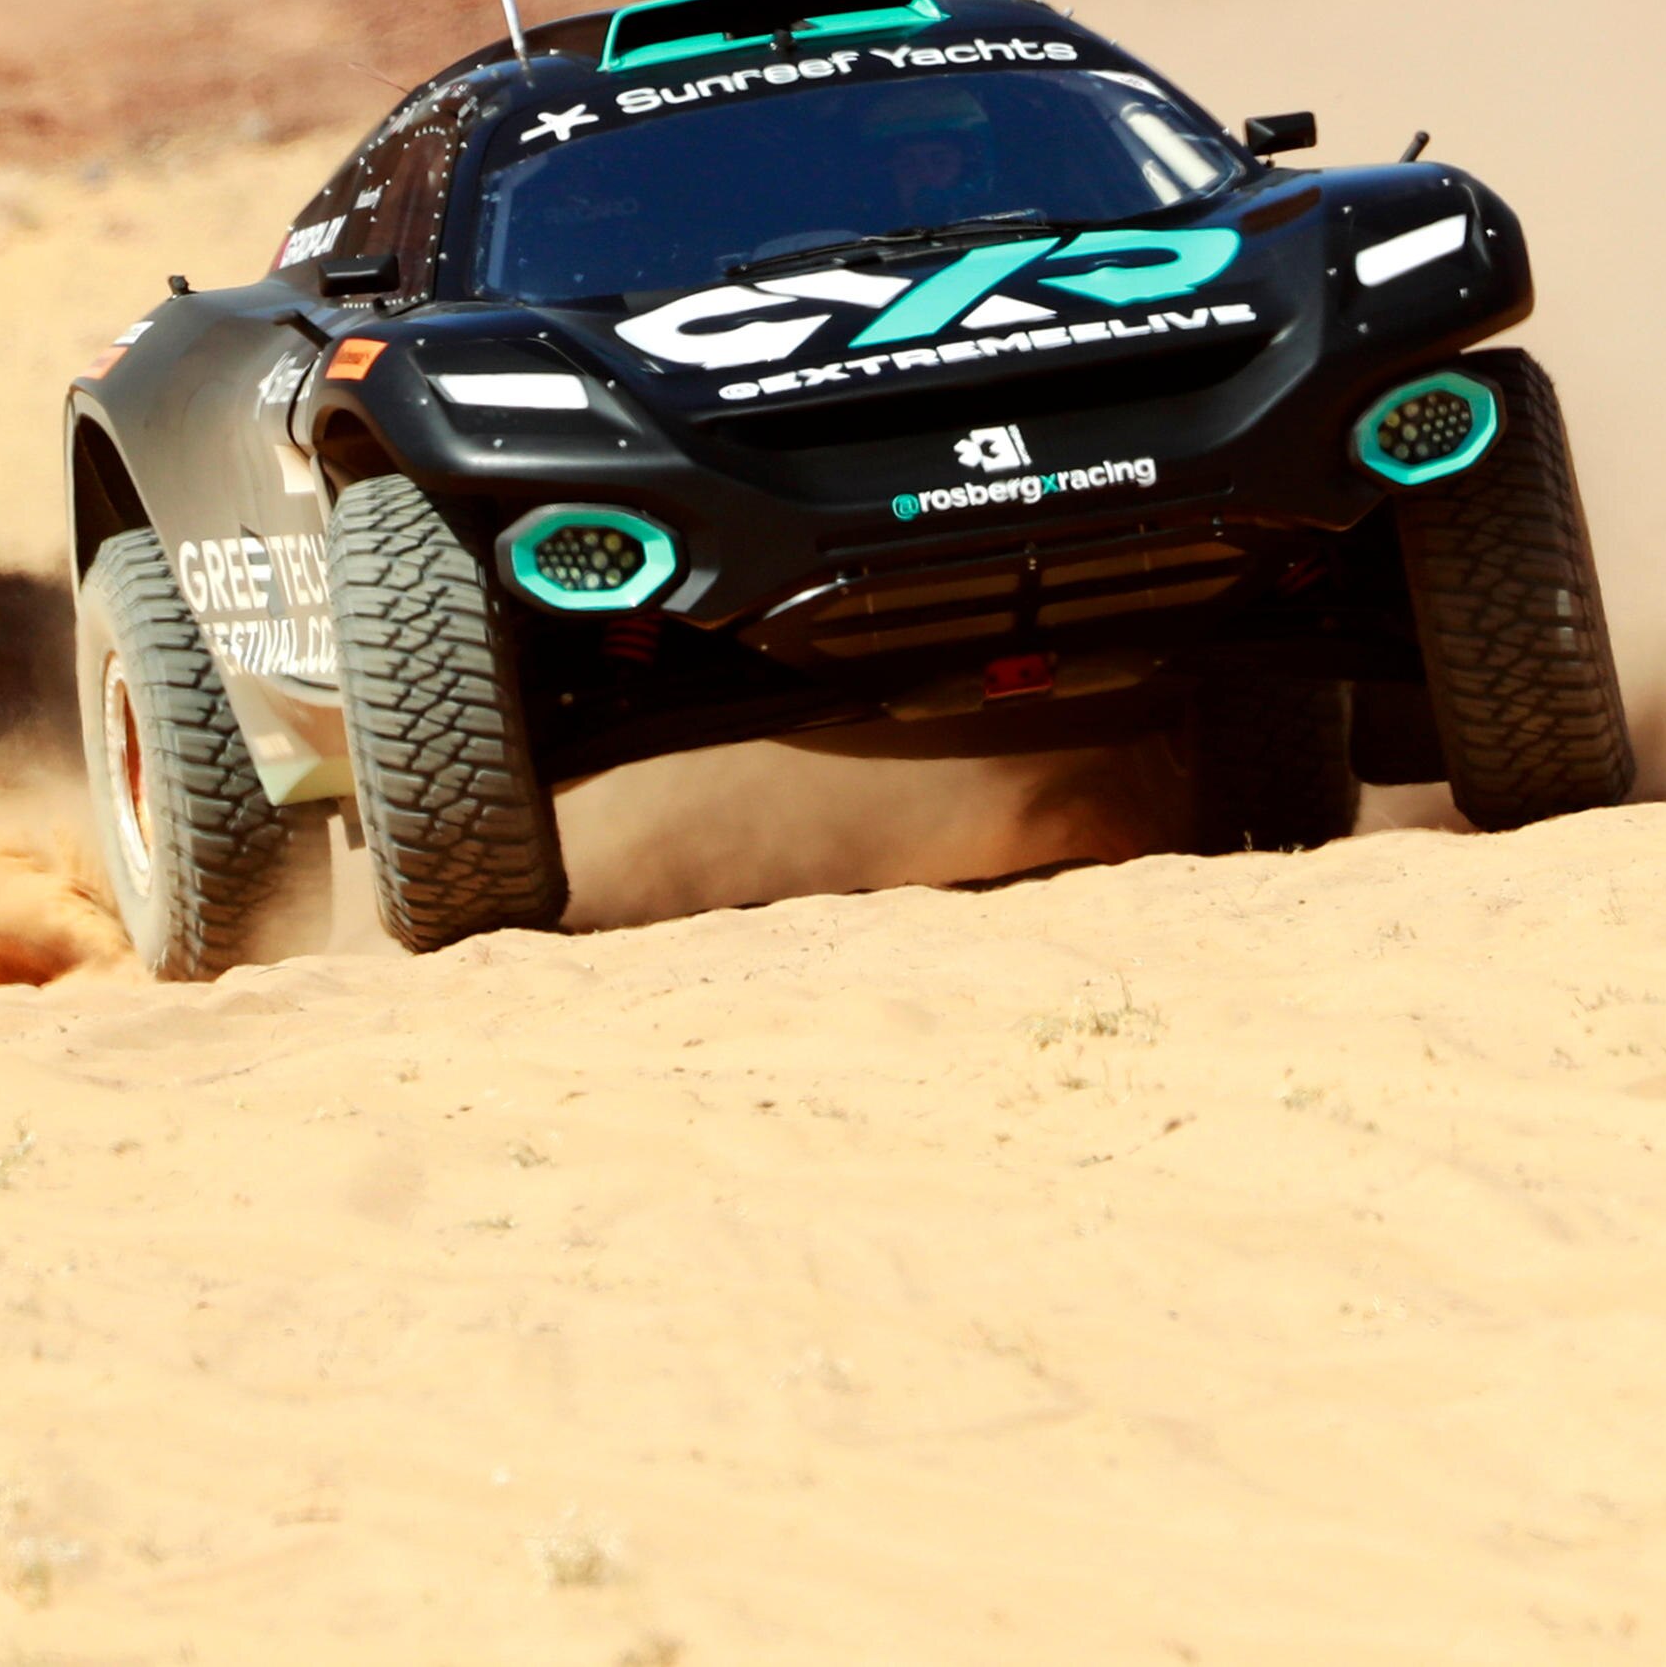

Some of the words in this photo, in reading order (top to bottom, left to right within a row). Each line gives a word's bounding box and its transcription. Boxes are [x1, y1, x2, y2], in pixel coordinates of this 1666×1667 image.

[615, 50, 861, 114] Sunreef
[870, 37, 1079, 69] Yachts
[718, 303, 1258, 401] @EXTREMEELIVE
[891, 457, 1157, 521] @rosbergxracing
